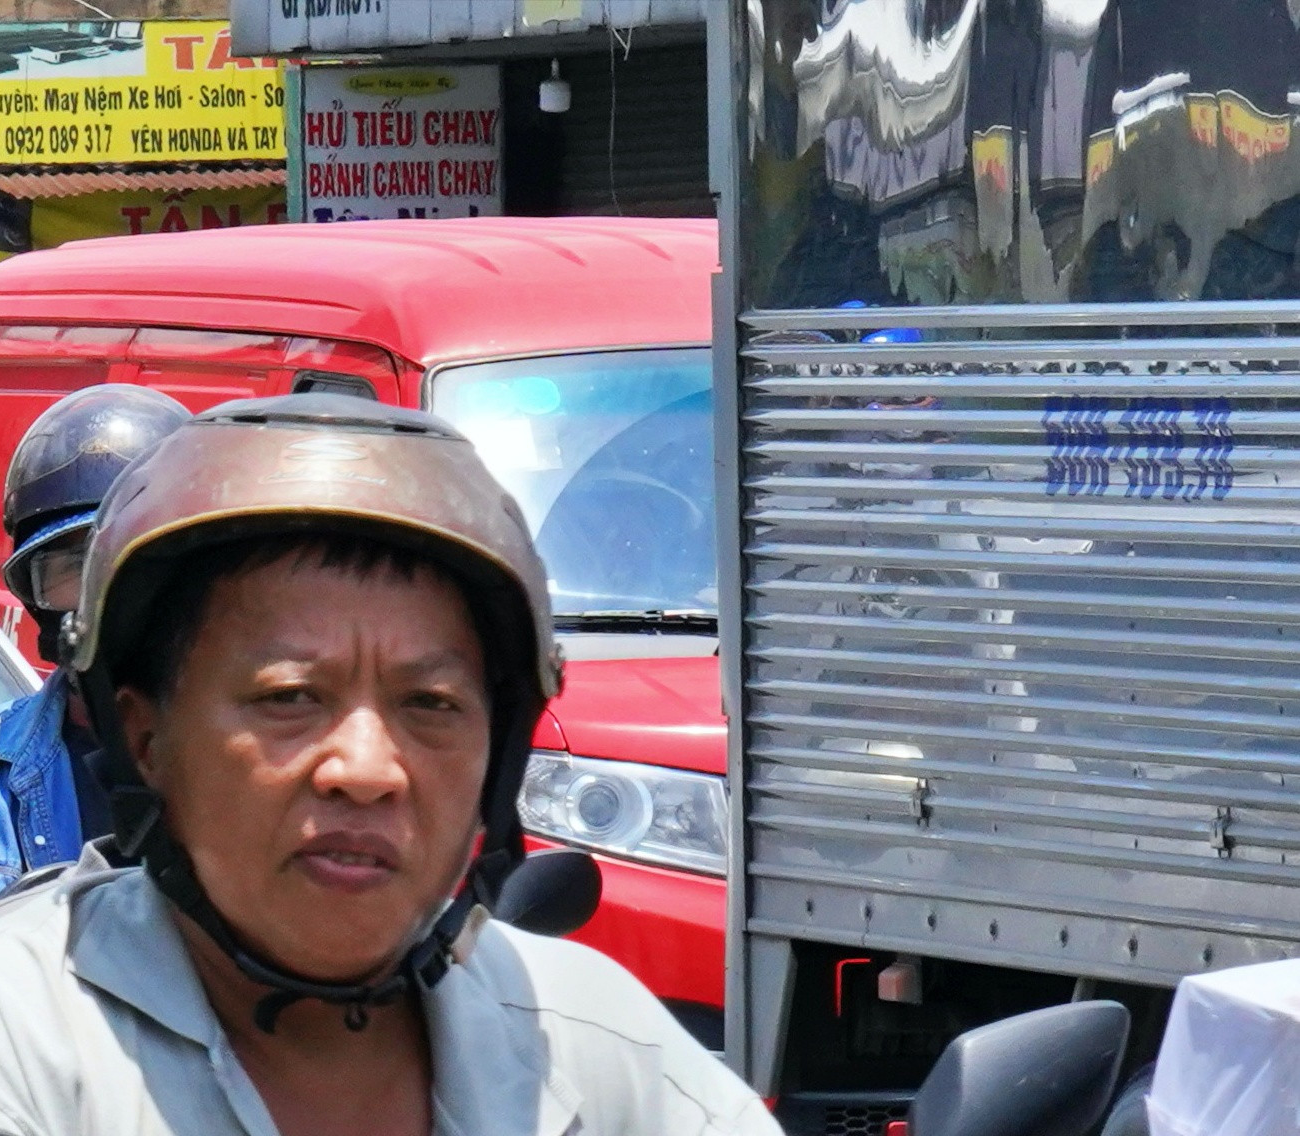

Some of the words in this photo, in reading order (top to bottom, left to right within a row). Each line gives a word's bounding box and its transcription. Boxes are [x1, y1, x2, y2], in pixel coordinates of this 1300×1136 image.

[44, 87, 80, 114] May
[84, 84, 123, 117] Nệm
[127, 85, 149, 110] Xe
[154, 84, 182, 109] Hơi
[199, 82, 247, 109] Salon
[263, 82, 285, 107] So
[5, 124, 45, 155] 0932
[49, 125, 79, 154] 089
[84, 123, 113, 154] 317
[131, 123, 164, 153] YÊN
[168, 126, 222, 153] HONDA
[227, 121, 248, 151] VÀ
[252, 125, 278, 151] TAY
[306, 98, 346, 148] HỦ
[422, 108, 498, 146] CHAY
[308, 153, 369, 198] BÁNH
[372, 160, 435, 198] CANH
[437, 159, 497, 197] CHAY
